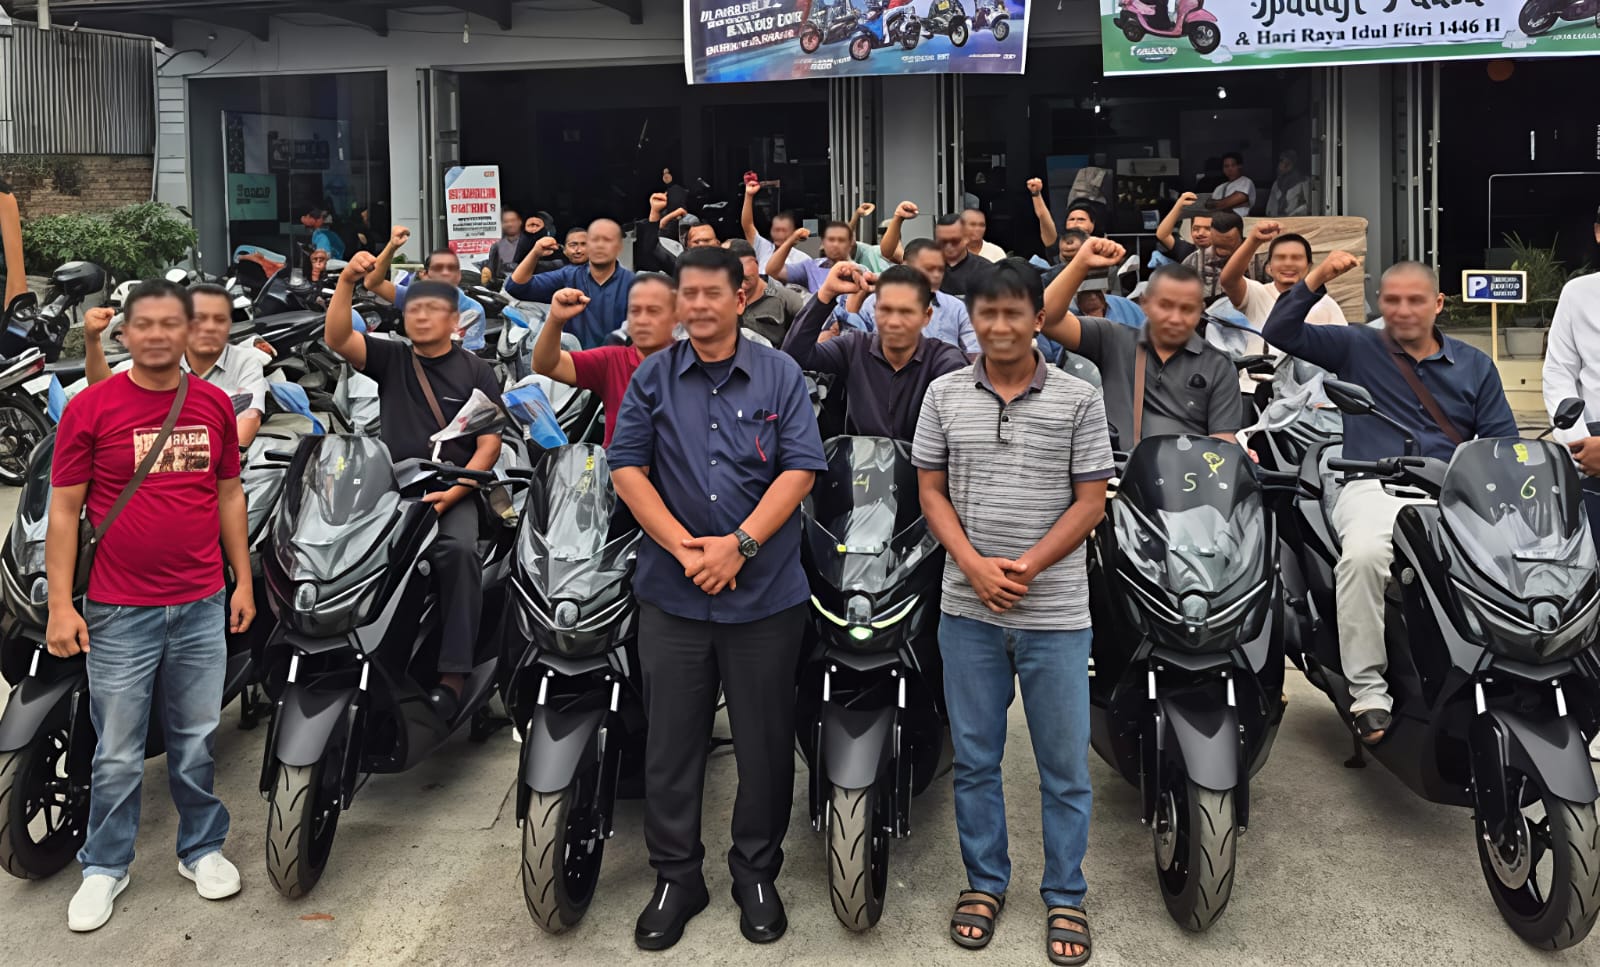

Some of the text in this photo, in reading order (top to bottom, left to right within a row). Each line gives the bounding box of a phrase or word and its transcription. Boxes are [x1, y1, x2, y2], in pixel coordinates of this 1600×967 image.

[1235, 17, 1500, 46] & Hari Raya Idul Fitri 1446 H
[1468, 276, 1488, 298] P
[1520, 474, 1536, 500] 6
